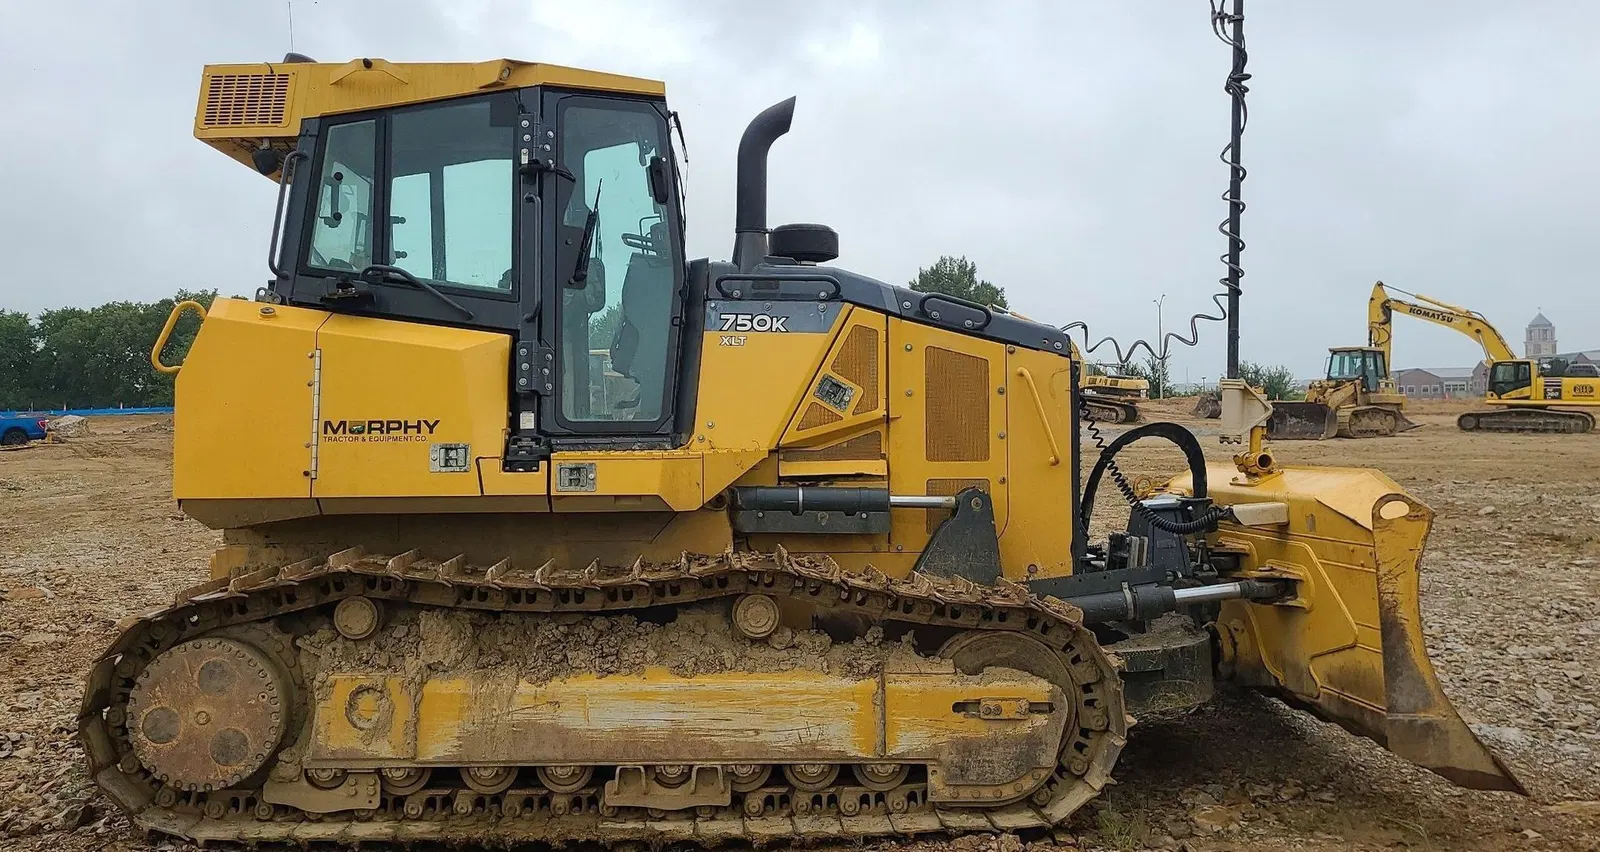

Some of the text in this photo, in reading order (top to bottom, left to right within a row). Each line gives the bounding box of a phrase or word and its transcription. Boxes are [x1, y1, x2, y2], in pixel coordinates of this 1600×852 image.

[1409, 307, 1453, 323] KOMATSU
[719, 313, 790, 333] 750K
[719, 335, 747, 347] XLT
[323, 435, 359, 443] TRACTOR
